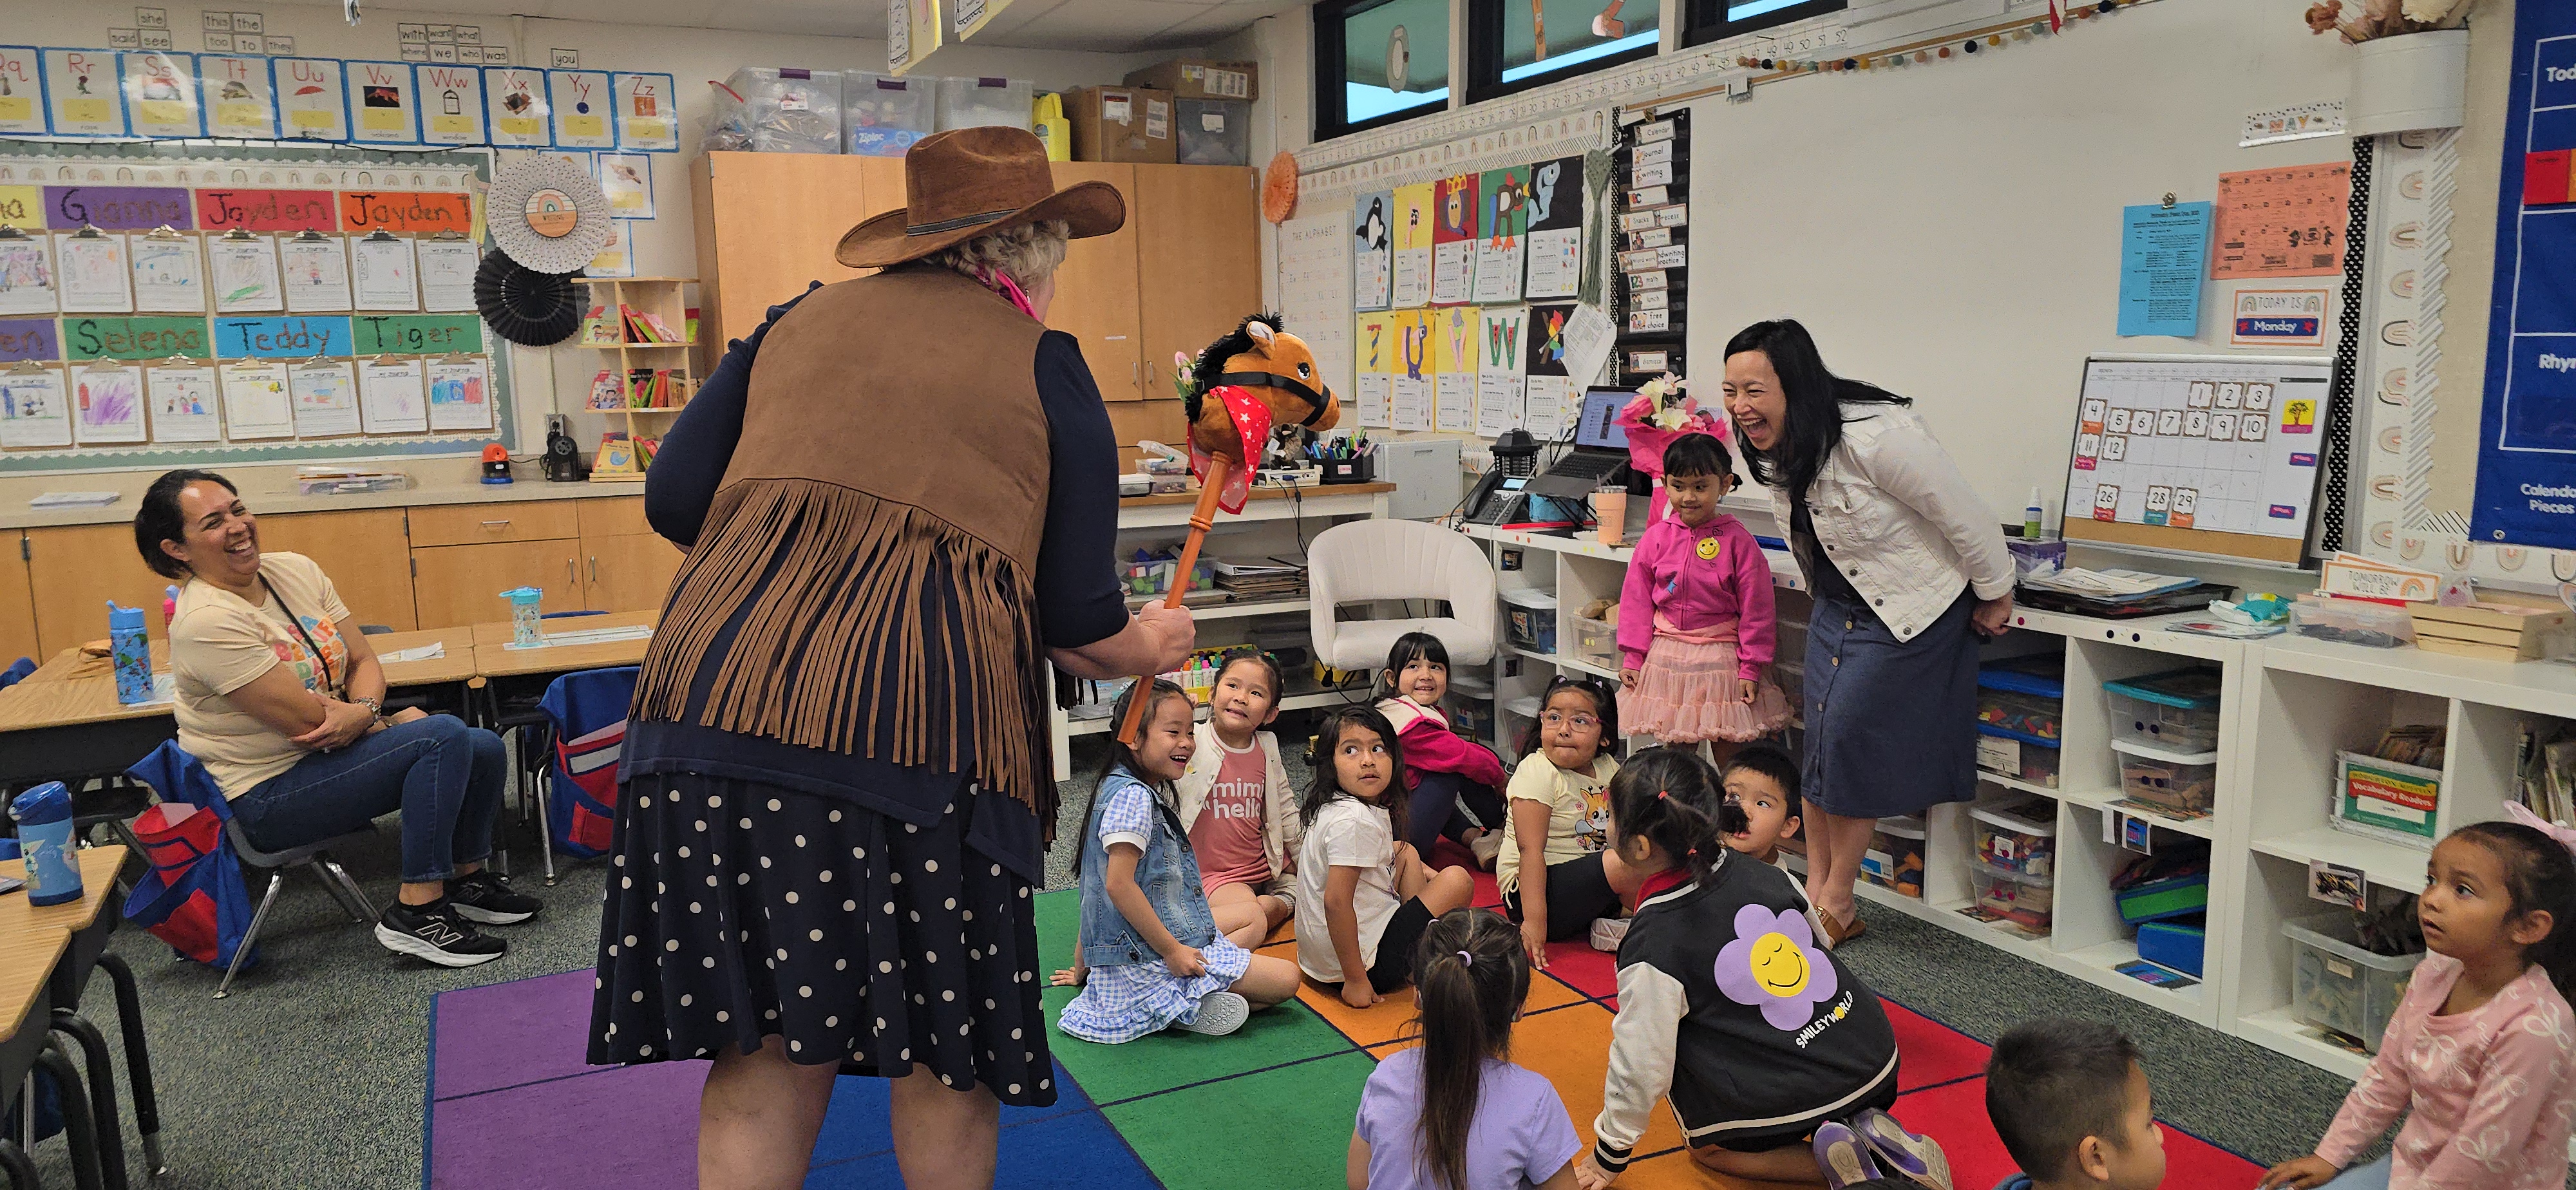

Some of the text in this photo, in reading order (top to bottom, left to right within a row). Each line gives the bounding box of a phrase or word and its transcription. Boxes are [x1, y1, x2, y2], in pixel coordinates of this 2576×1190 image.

[140, 13, 163, 24] she
[236, 17, 260, 30] the
[144, 35, 169, 46] see
[402, 30, 426, 40] with
[456, 30, 478, 40] what
[1799, 39, 1811, 50] 50
[1818, 34, 1826, 46] 51
[1835, 29, 1847, 42] 52
[242, 38, 256, 51] to
[268, 41, 292, 53] they
[433, 48, 452, 59] we
[484, 51, 507, 61] was
[554, 53, 576, 66] you
[68, 53, 96, 74] Rr
[145, 55, 172, 77] Ss
[221, 59, 248, 80] Tt
[292, 62, 325, 83] Uu
[366, 65, 393, 85] Vv
[428, 68, 469, 90] Ww
[502, 71, 529, 91] Xx
[567, 74, 591, 102] Yy
[630, 76, 656, 97] Zz
[1647, 125, 1671, 137] Calendar
[2269, 114, 2309, 133] MAY
[858, 132, 885, 145] Ziploc
[1642, 146, 1663, 161] journal
[1642, 169, 1663, 178] writing
[61, 189, 182, 225] Gianna
[208, 193, 328, 226] Jayden
[350, 193, 453, 229] Jayden
[1658, 250, 1685, 259] ndwriting
[2258, 297, 2304, 308] TODAY IS
[1649, 311, 1662, 319] free
[363, 316, 462, 350] Tiger
[2254, 320, 2297, 334] Monday
[78, 319, 200, 354] Selena
[227, 319, 330, 356] Teddy
[2198, 388, 2263, 402] 1 2 3
[2091, 404, 2260, 433] 4 5 6 7 8 9 10
[2085, 440, 2120, 453] 11 12
[2100, 491, 2193, 507] 26 28 29
[2530, 499, 2575, 514] Pieces
[2349, 571, 2401, 587] TOMORROW
[2353, 579, 2390, 596] WILL BE
[1213, 777, 1264, 798] mimi
[2353, 782, 2398, 800] Vocabulary
[2398, 793, 2432, 806] Readers
[1796, 990, 1853, 1049] SMILEYWORLD
